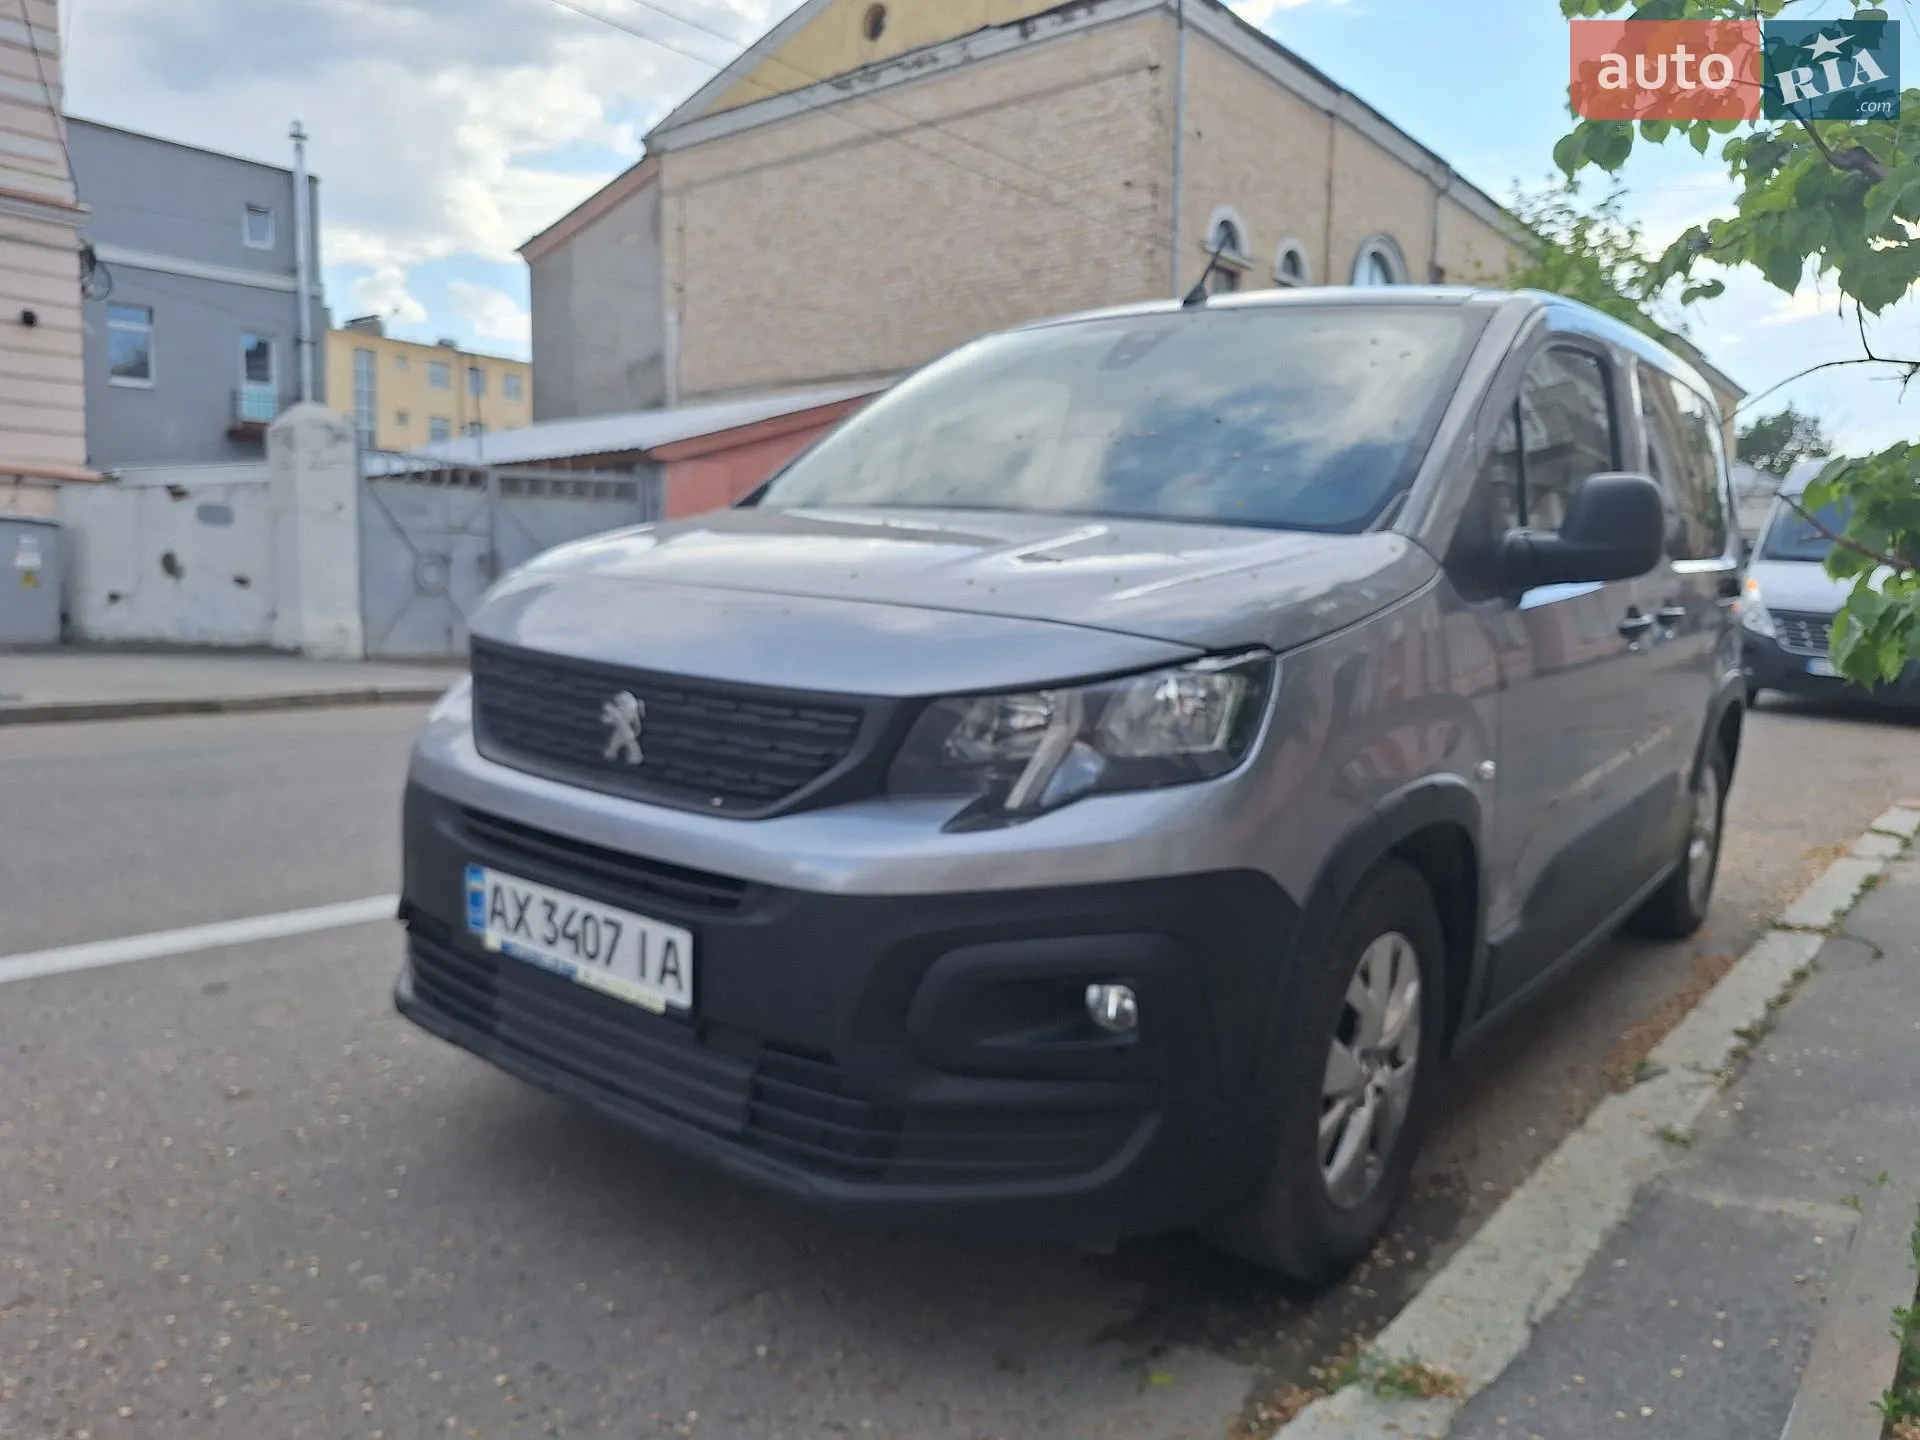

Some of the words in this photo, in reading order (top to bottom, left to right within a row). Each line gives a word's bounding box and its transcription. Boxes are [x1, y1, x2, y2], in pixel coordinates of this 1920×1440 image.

[489, 883, 533, 939] AX
[540, 898, 623, 967] 3407
[639, 928, 684, 992] IA
